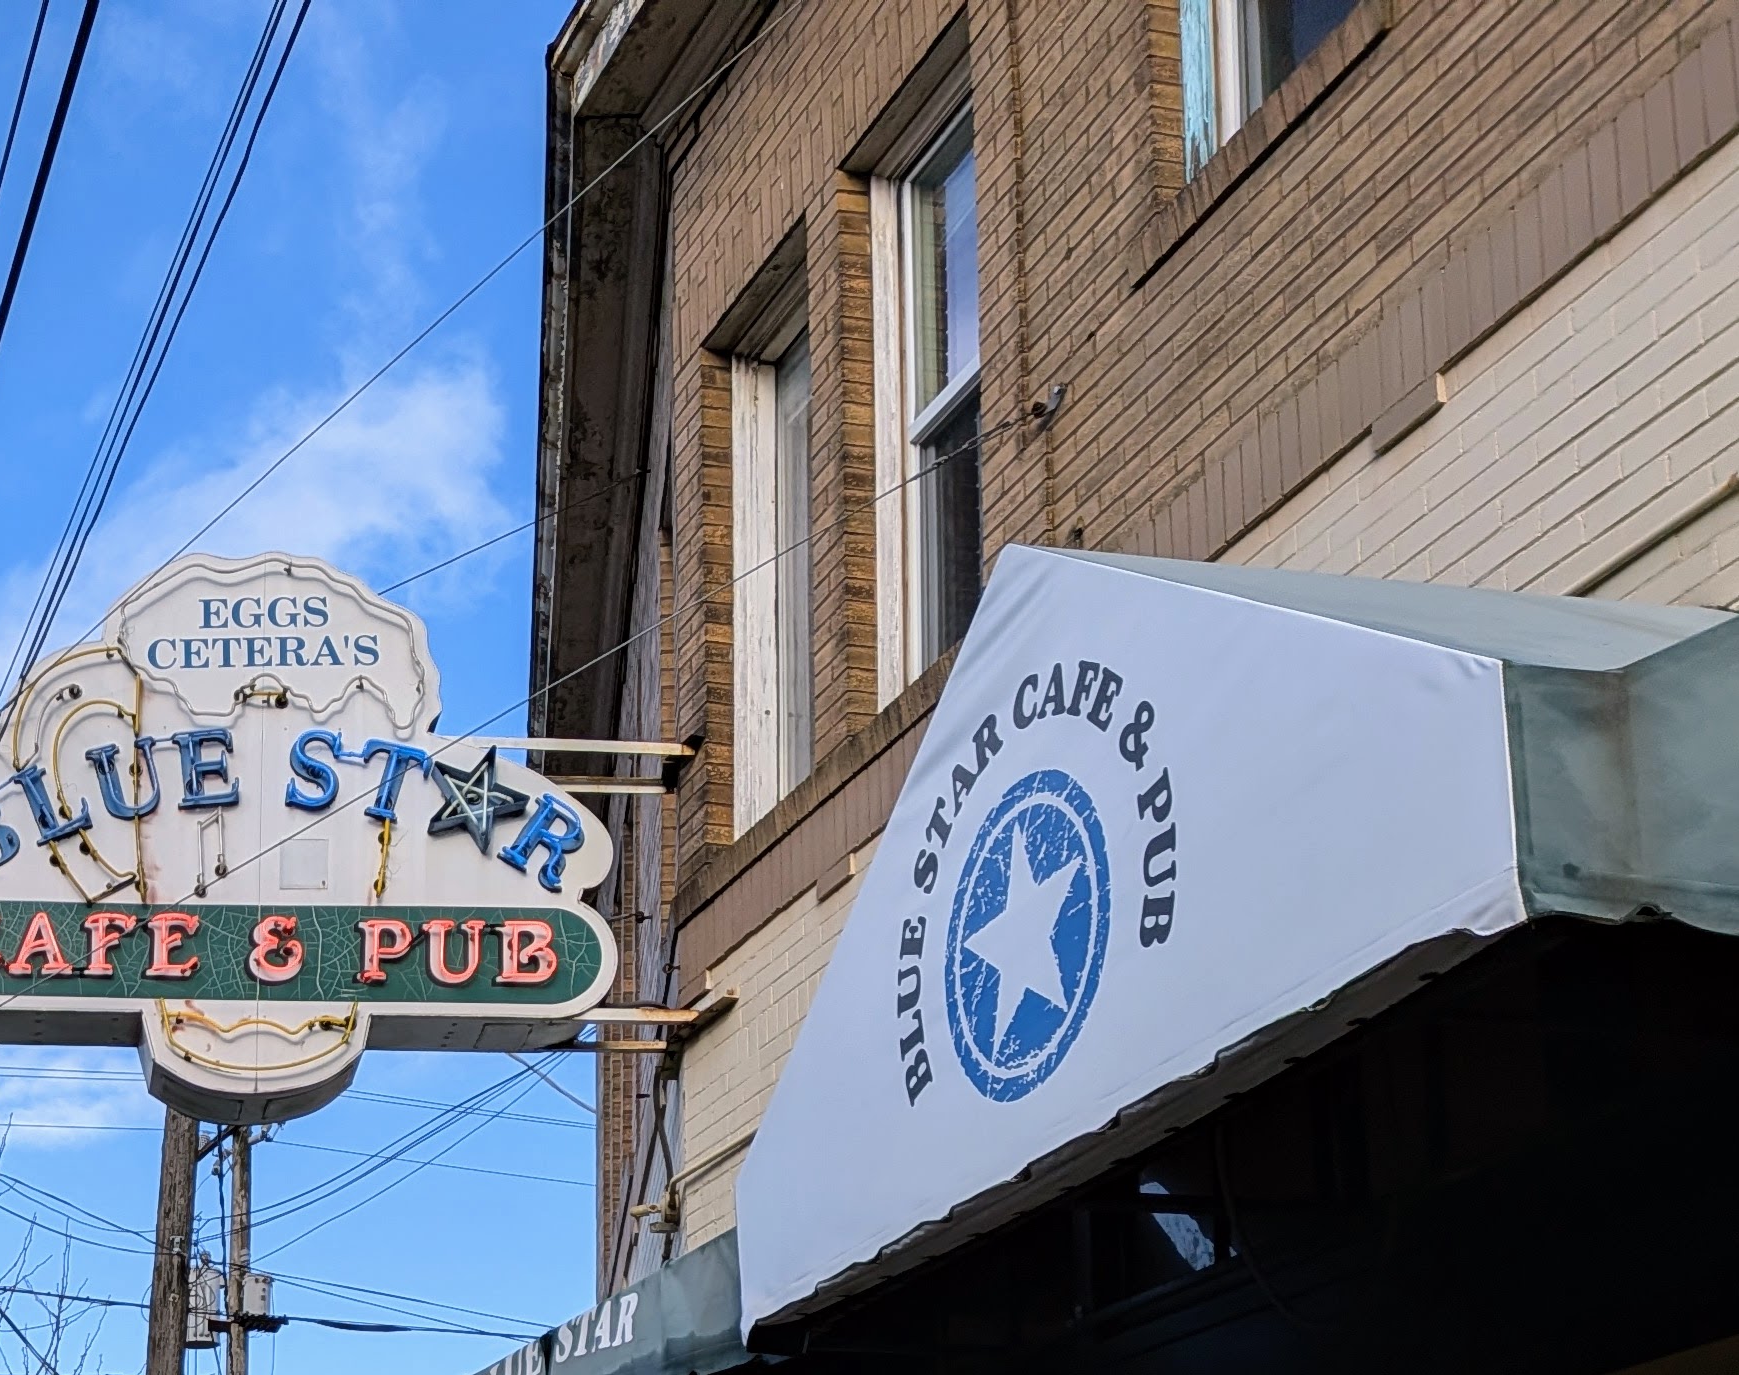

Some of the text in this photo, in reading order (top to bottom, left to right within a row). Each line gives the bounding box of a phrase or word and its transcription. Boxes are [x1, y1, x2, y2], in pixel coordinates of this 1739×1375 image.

[198, 596, 329, 629] EGGS
[147, 635, 381, 670] CETERA'S
[897, 659, 1178, 1108] BLUE STAR CAFE & PUB
[246, 915, 304, 984] &
[356, 917, 560, 987] PUB
[554, 1292, 640, 1363] STAR
